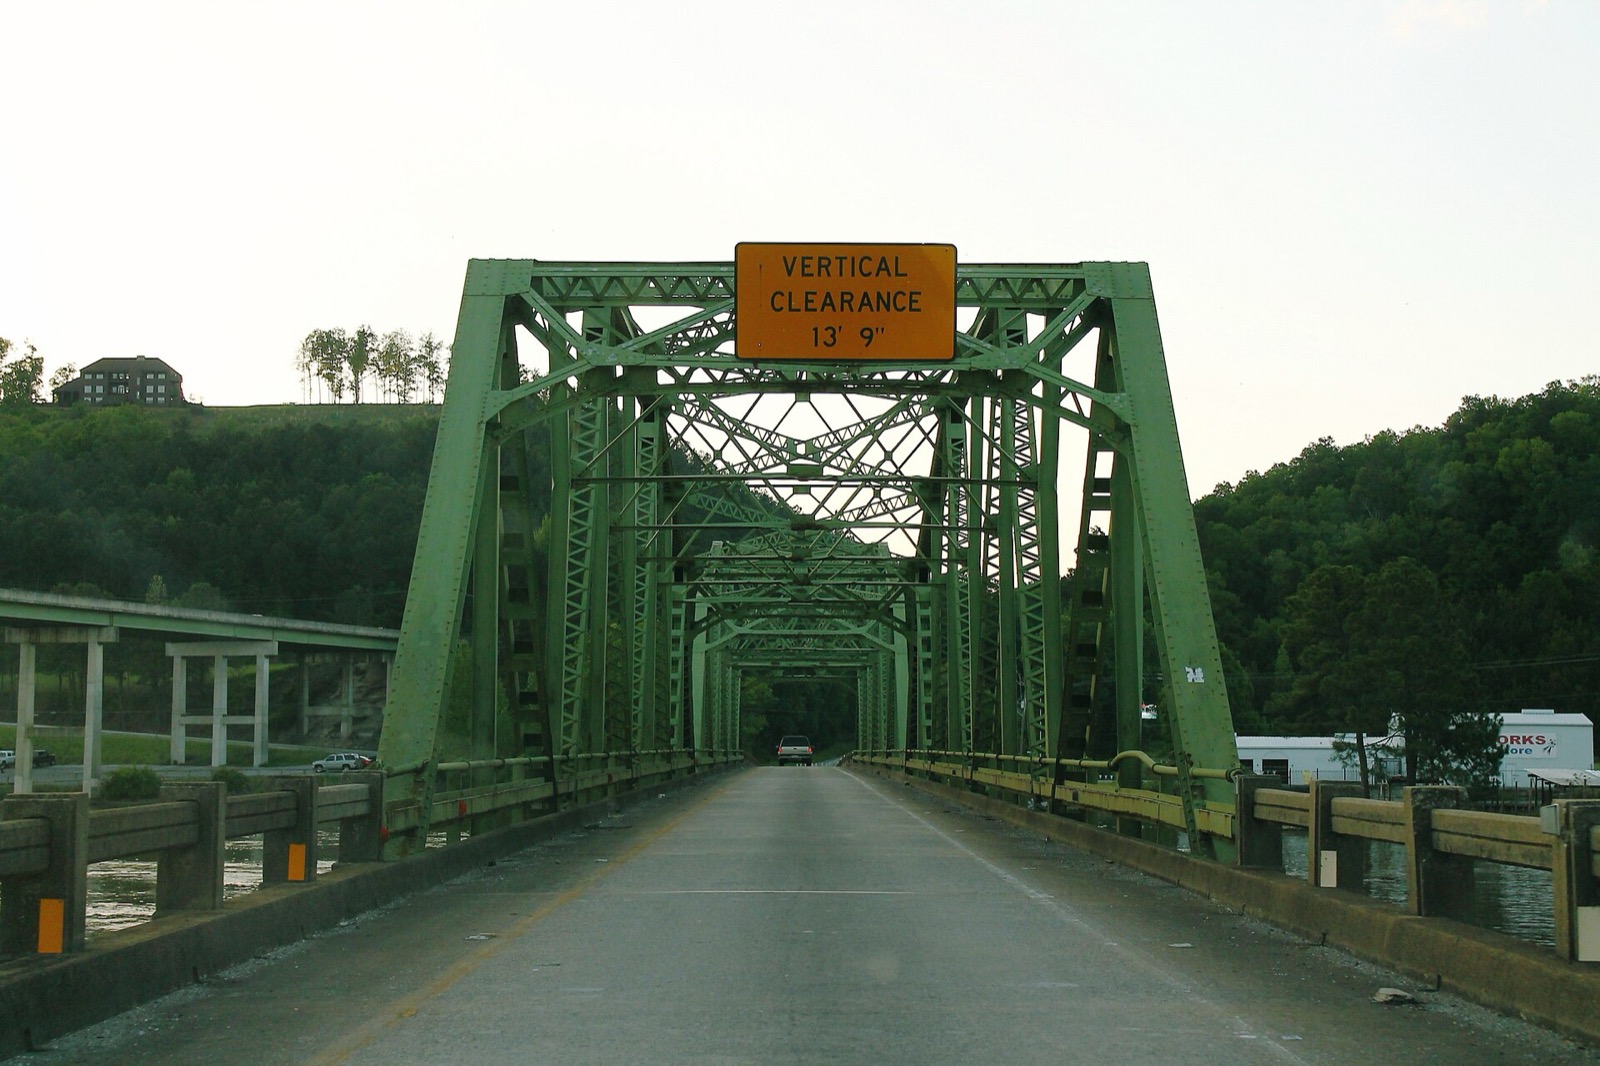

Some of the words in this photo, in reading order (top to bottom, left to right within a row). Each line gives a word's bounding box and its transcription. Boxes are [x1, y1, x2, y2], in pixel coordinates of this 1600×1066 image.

[783, 256, 907, 277] VERTICAL
[770, 291, 922, 313] CLEARANCE
[812, 326, 843, 348] 13'
[1497, 735, 1546, 745] ORKS
[1510, 747, 1533, 755] ore
